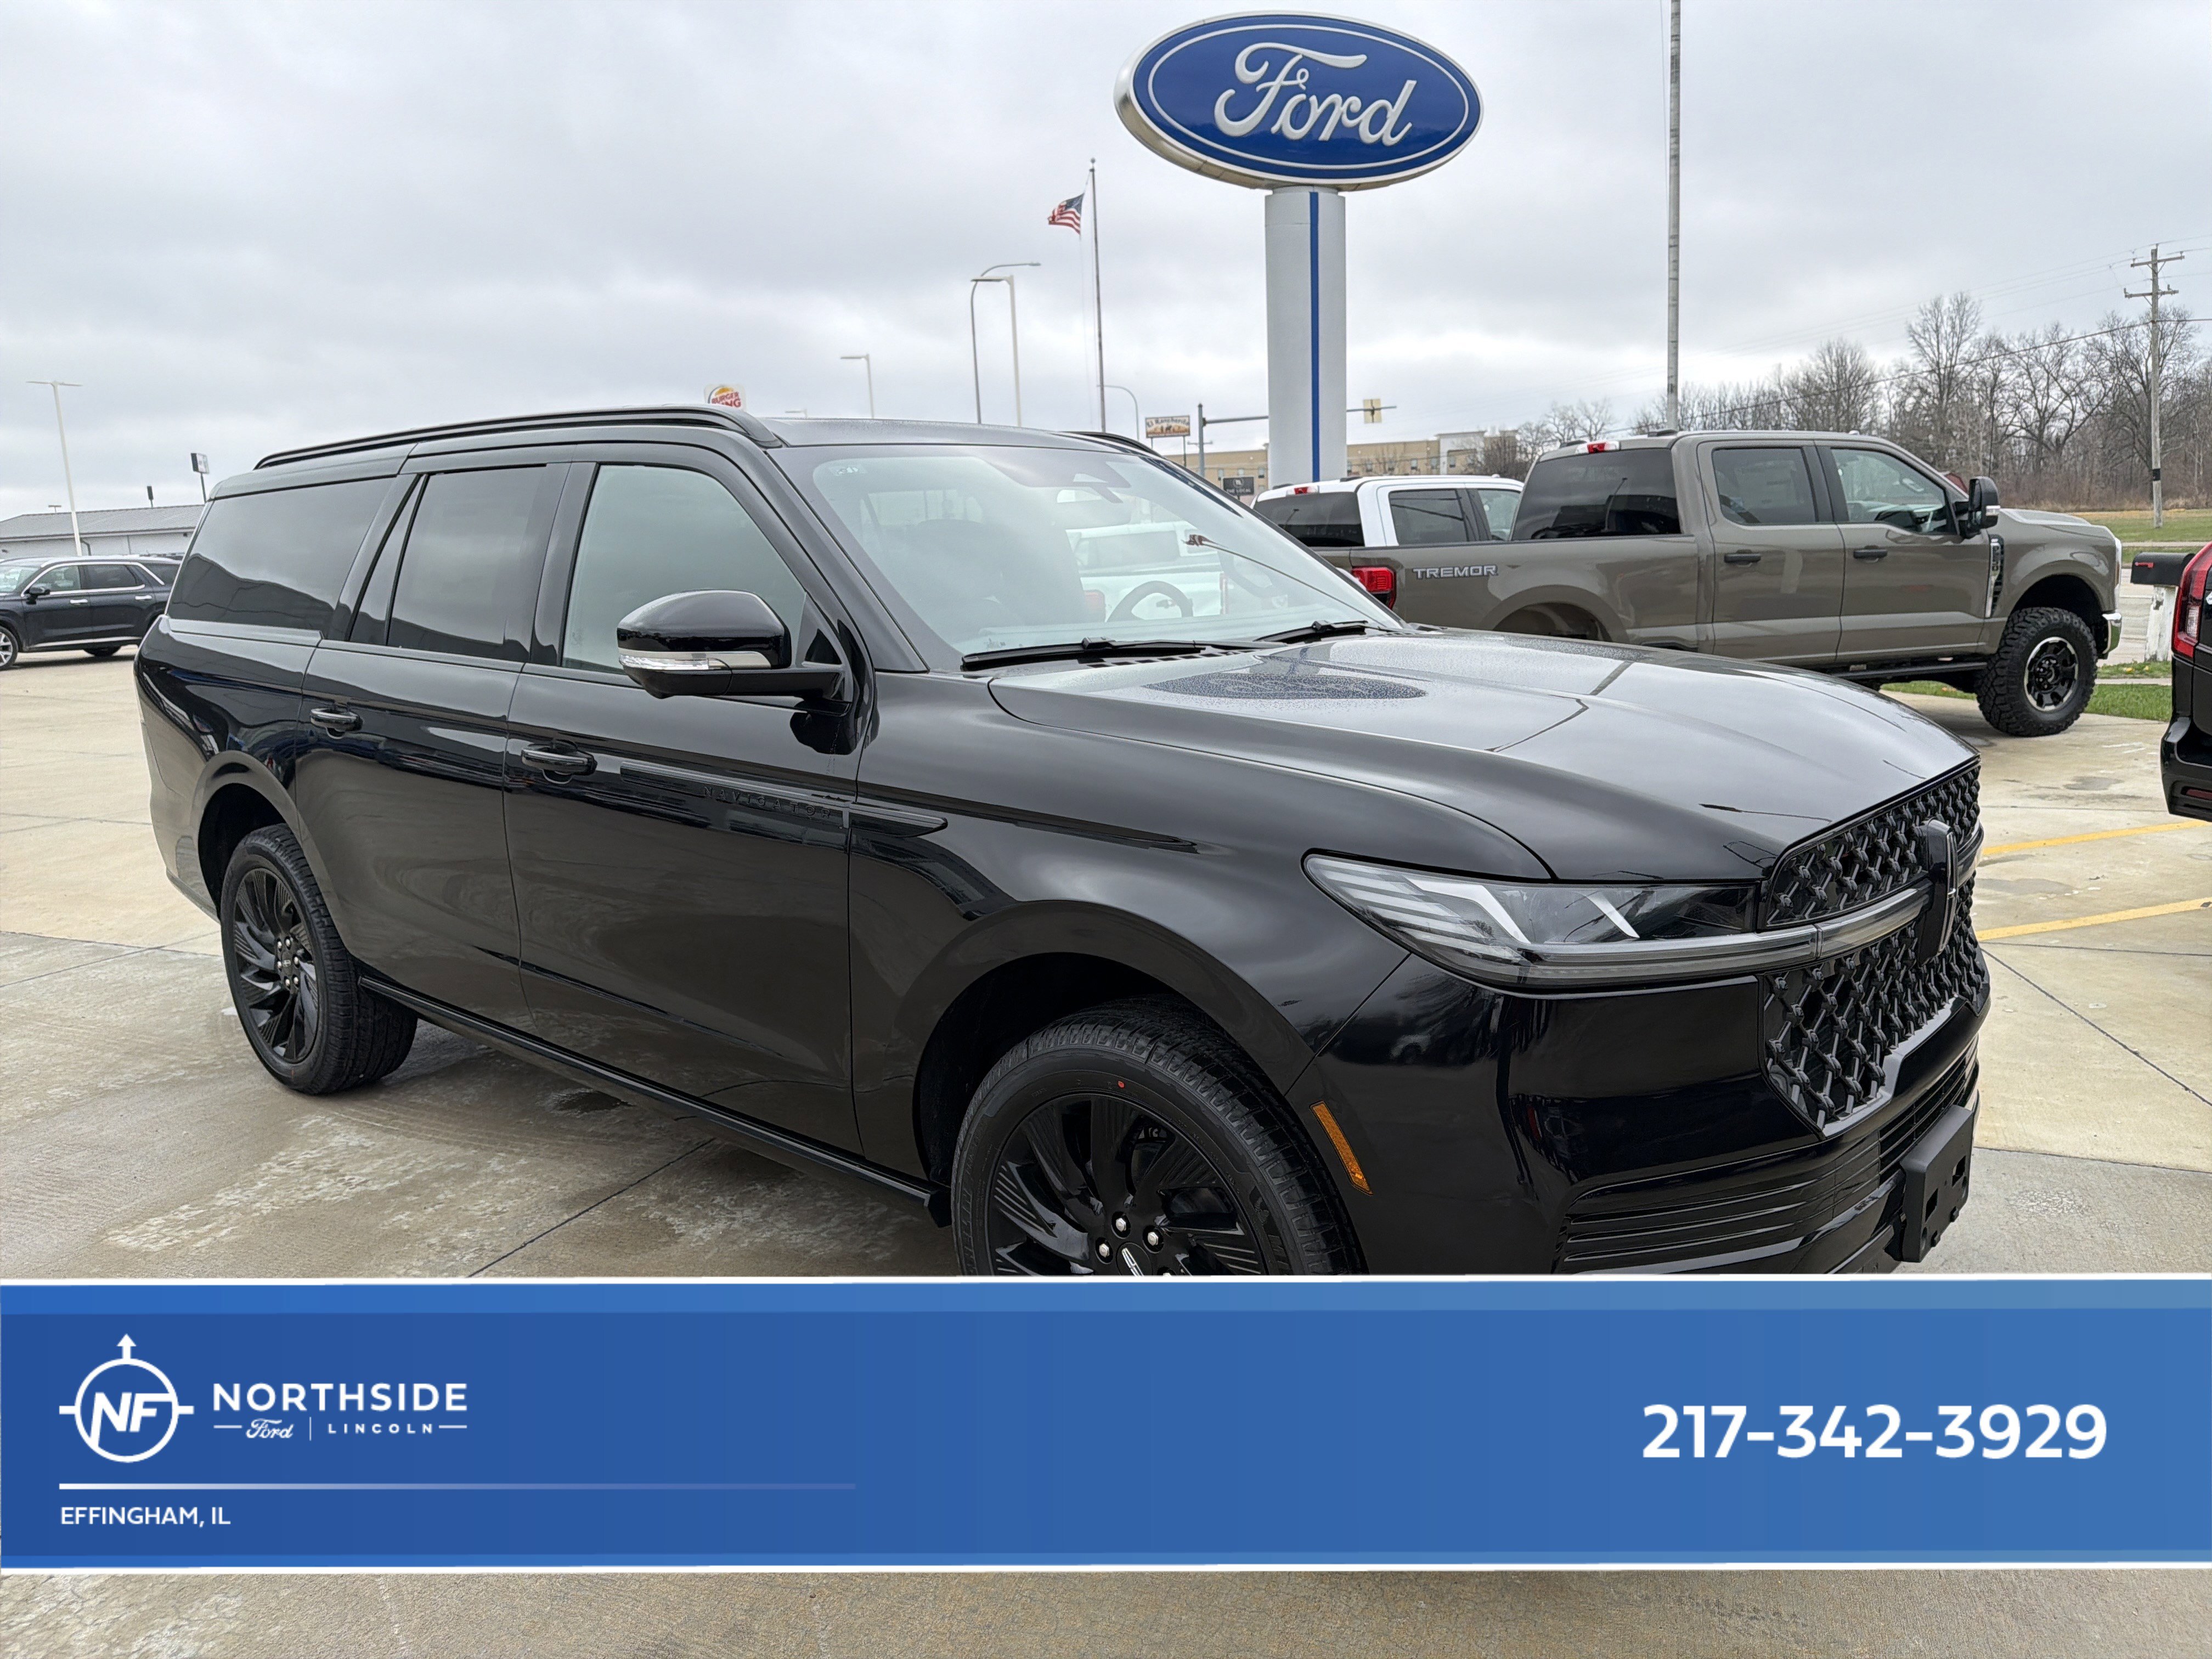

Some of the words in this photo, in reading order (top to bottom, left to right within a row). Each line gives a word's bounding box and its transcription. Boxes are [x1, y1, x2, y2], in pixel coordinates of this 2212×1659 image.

[1214, 42, 1418, 147] Ford
[712, 391, 739, 404] BURGER
[1413, 565, 1498, 580] TREMOR
[704, 786, 831, 819] NAVIGATOR
